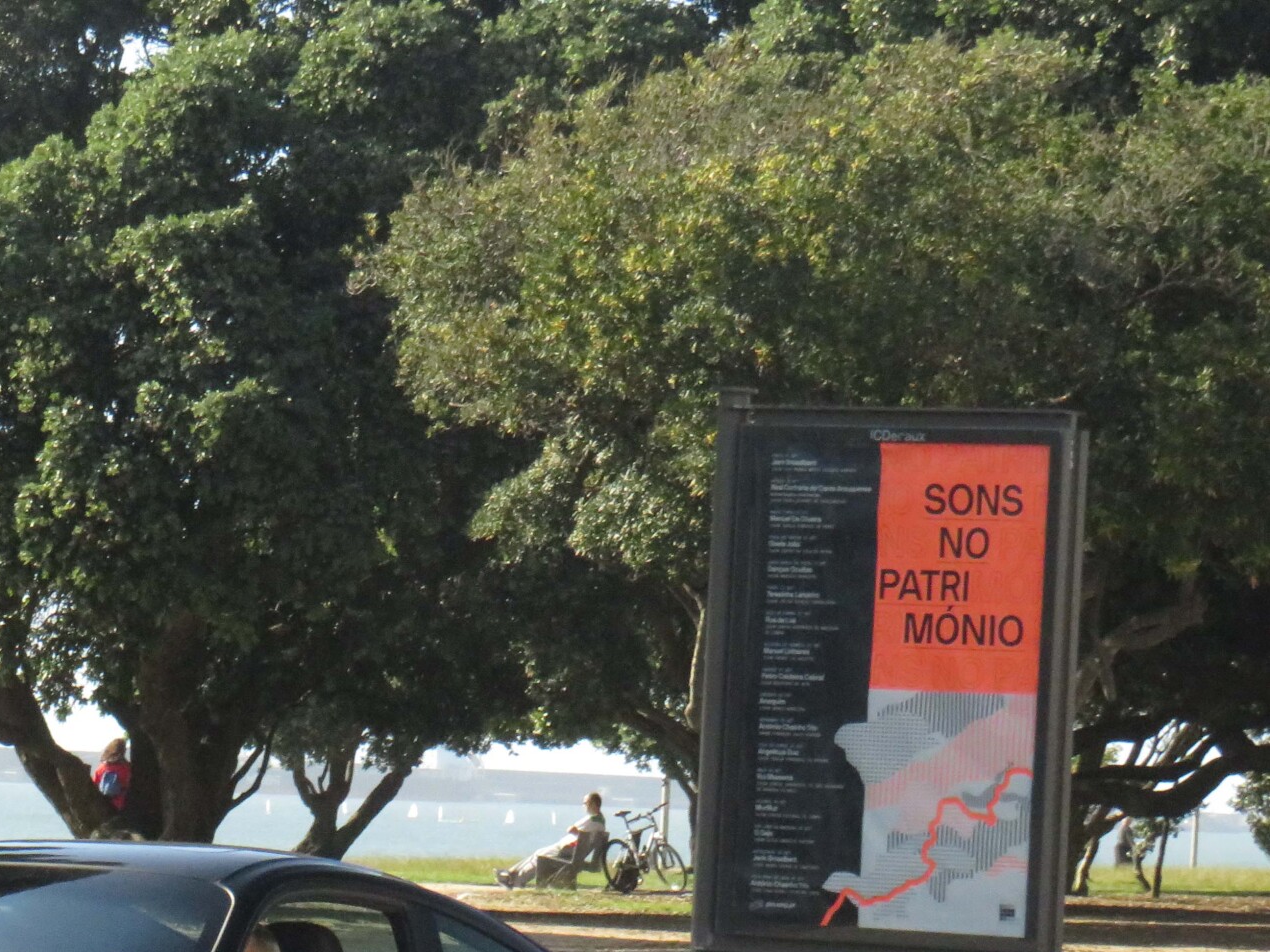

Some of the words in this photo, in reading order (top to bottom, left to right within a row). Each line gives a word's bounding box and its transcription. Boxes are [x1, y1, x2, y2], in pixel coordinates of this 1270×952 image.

[923, 483, 1023, 517] SONS
[938, 527, 990, 559] NO
[879, 568, 970, 602] PATRI
[903, 605, 1024, 647] MÓNIO
